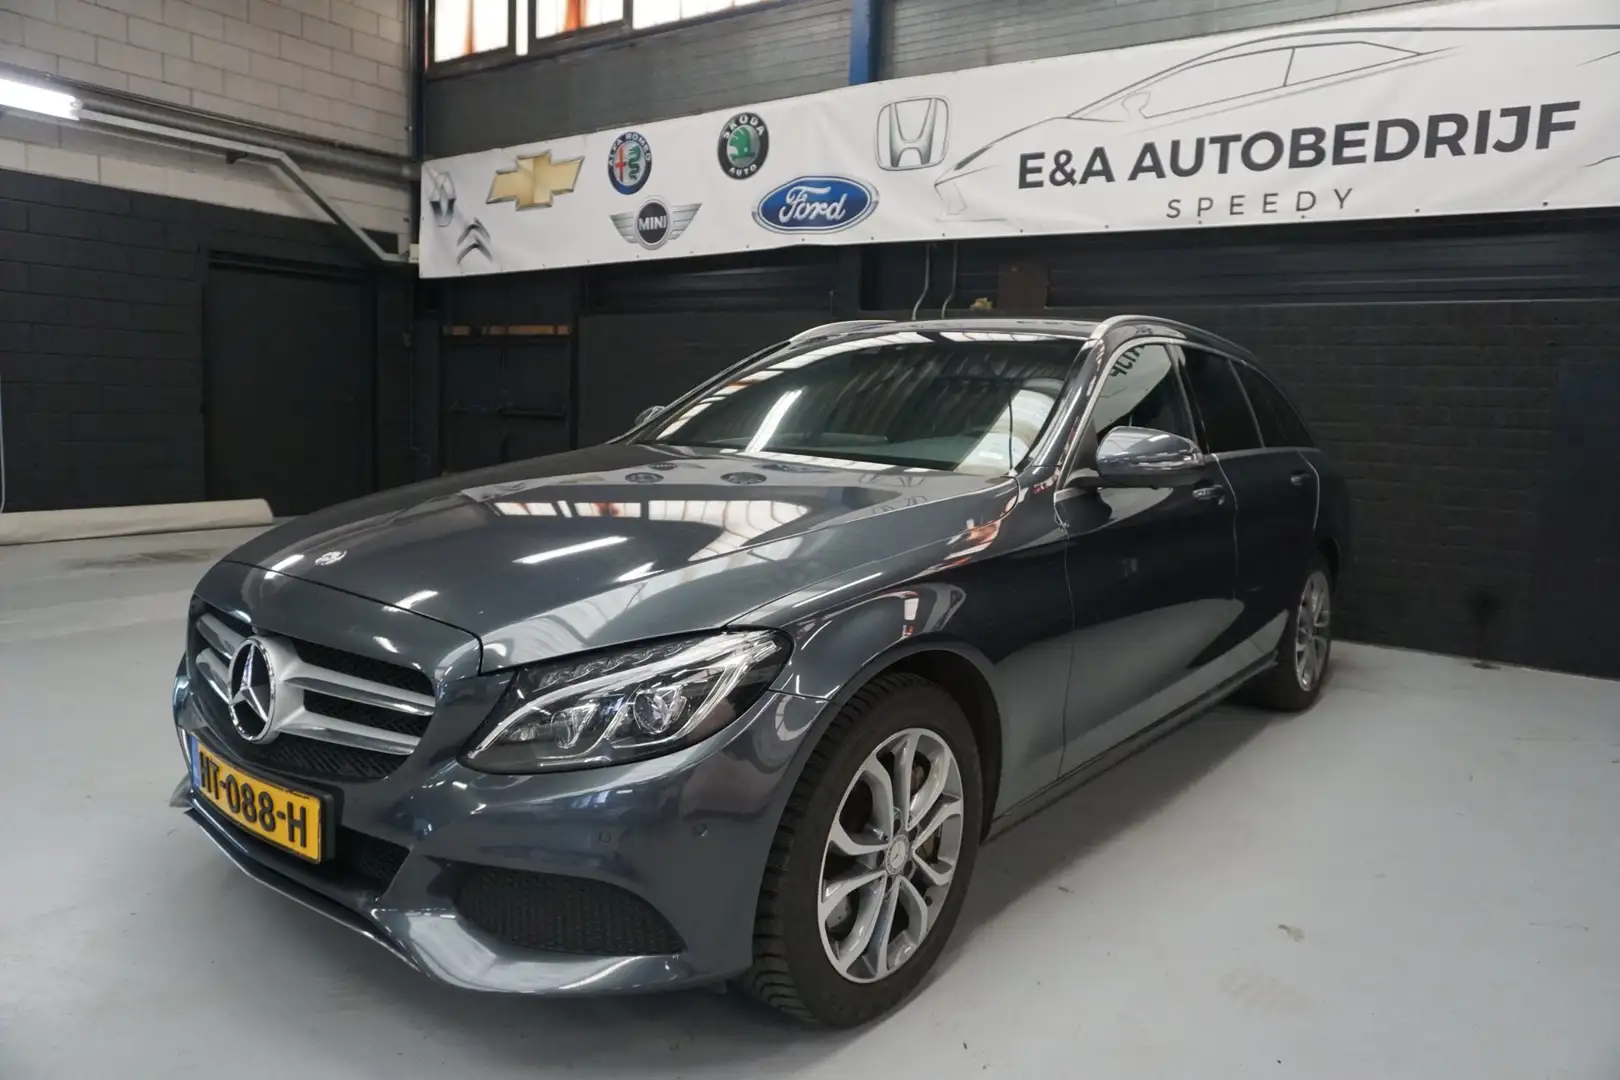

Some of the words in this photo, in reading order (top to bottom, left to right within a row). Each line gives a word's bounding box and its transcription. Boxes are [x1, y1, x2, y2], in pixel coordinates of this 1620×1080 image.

[1018, 147, 1115, 189] E&A
[1128, 101, 1580, 182] AUTOBEDRIJF
[729, 163, 757, 177] AUTO
[779, 186, 848, 223] Ford
[1166, 188, 1353, 219] SPEEDY
[639, 215, 667, 231] MINI
[200, 751, 307, 849] HT-088-H
